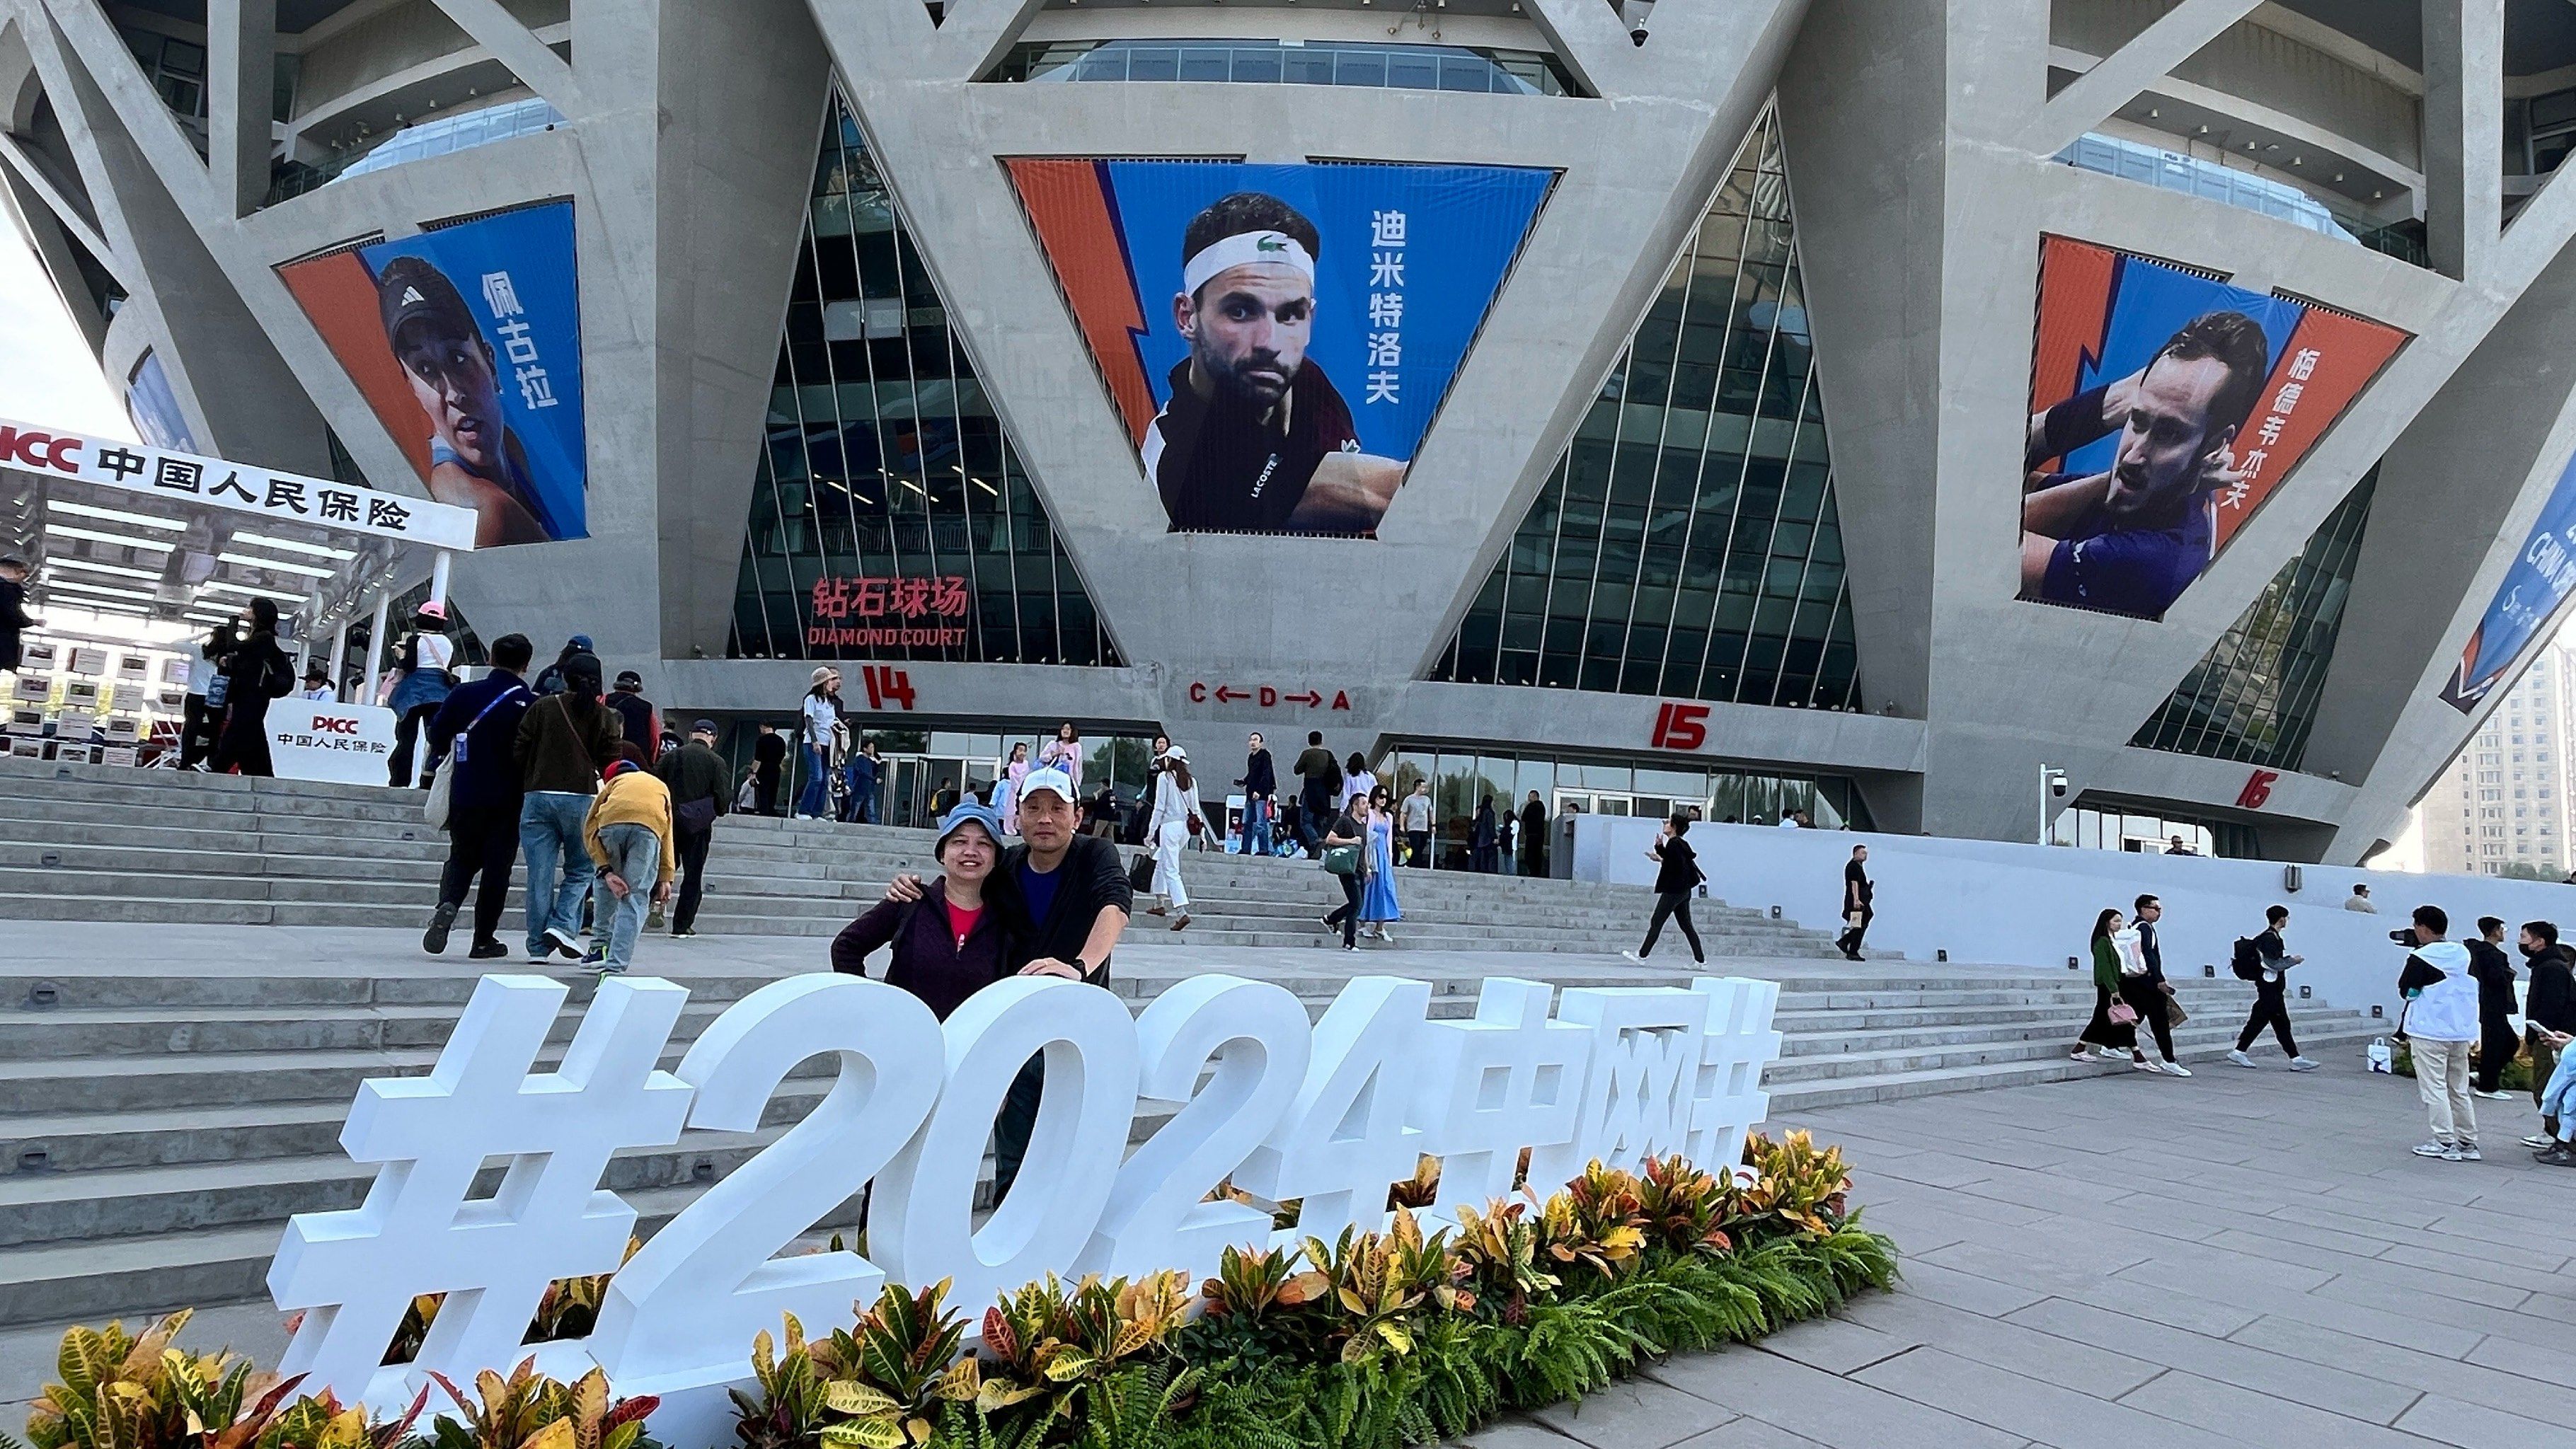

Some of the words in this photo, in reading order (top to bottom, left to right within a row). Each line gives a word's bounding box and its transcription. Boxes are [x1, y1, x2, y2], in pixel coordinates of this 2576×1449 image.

[1366, 209, 1407, 405] 迪米特洛夫
[481, 270, 558, 410] 佩古拉
[2219, 347, 2321, 510] 梅德韦杰夫
[0, 426, 83, 473] ICC
[98, 447, 410, 531] 中国人民保险
[1250, 460, 1277, 498] LACOSTE
[812, 576, 968, 618] 钻石球场
[808, 627, 897, 646] DIAMOND
[900, 628, 966, 647] COURT
[862, 665, 916, 710] 14
[1190, 681, 1207, 703] C
[1260, 686, 1277, 707] D
[1331, 690, 1350, 710] A
[277, 733, 388, 754] 中国人民保险
[311, 715, 359, 735] PICC
[1650, 703, 1711, 751] 15
[2235, 768, 2279, 809] 16
